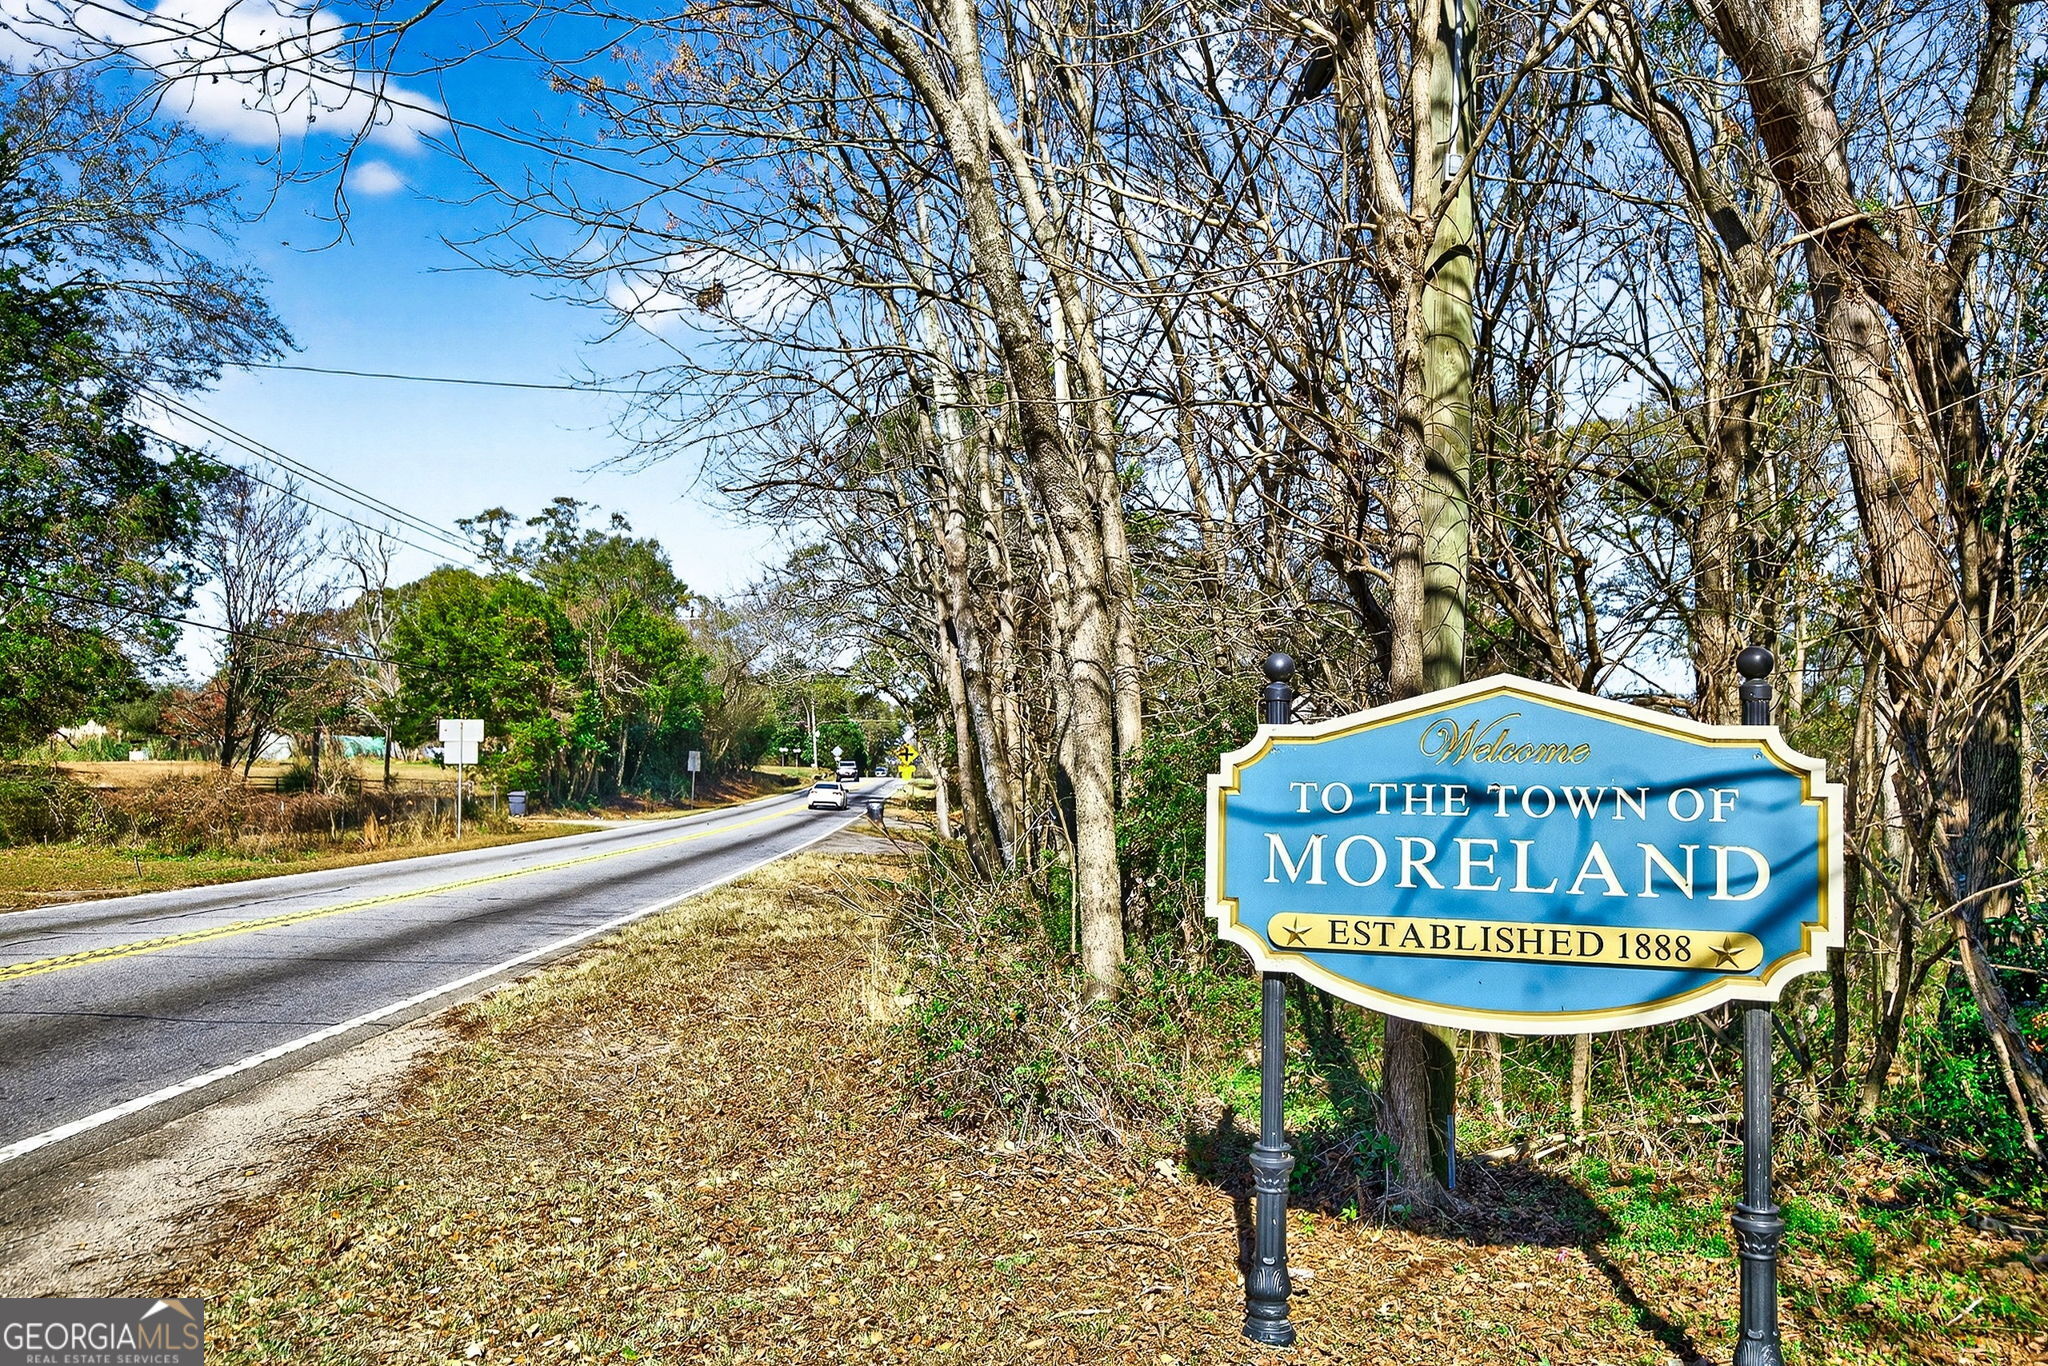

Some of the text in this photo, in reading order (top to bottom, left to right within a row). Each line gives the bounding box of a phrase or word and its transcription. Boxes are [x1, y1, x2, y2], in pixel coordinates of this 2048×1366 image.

[1419, 711, 1591, 767] Welcome
[1289, 781, 1741, 824] TO THE TOWN OF
[1263, 832, 1772, 902] MORELAND
[1327, 919, 1693, 963] ESTABLISHED 1888
